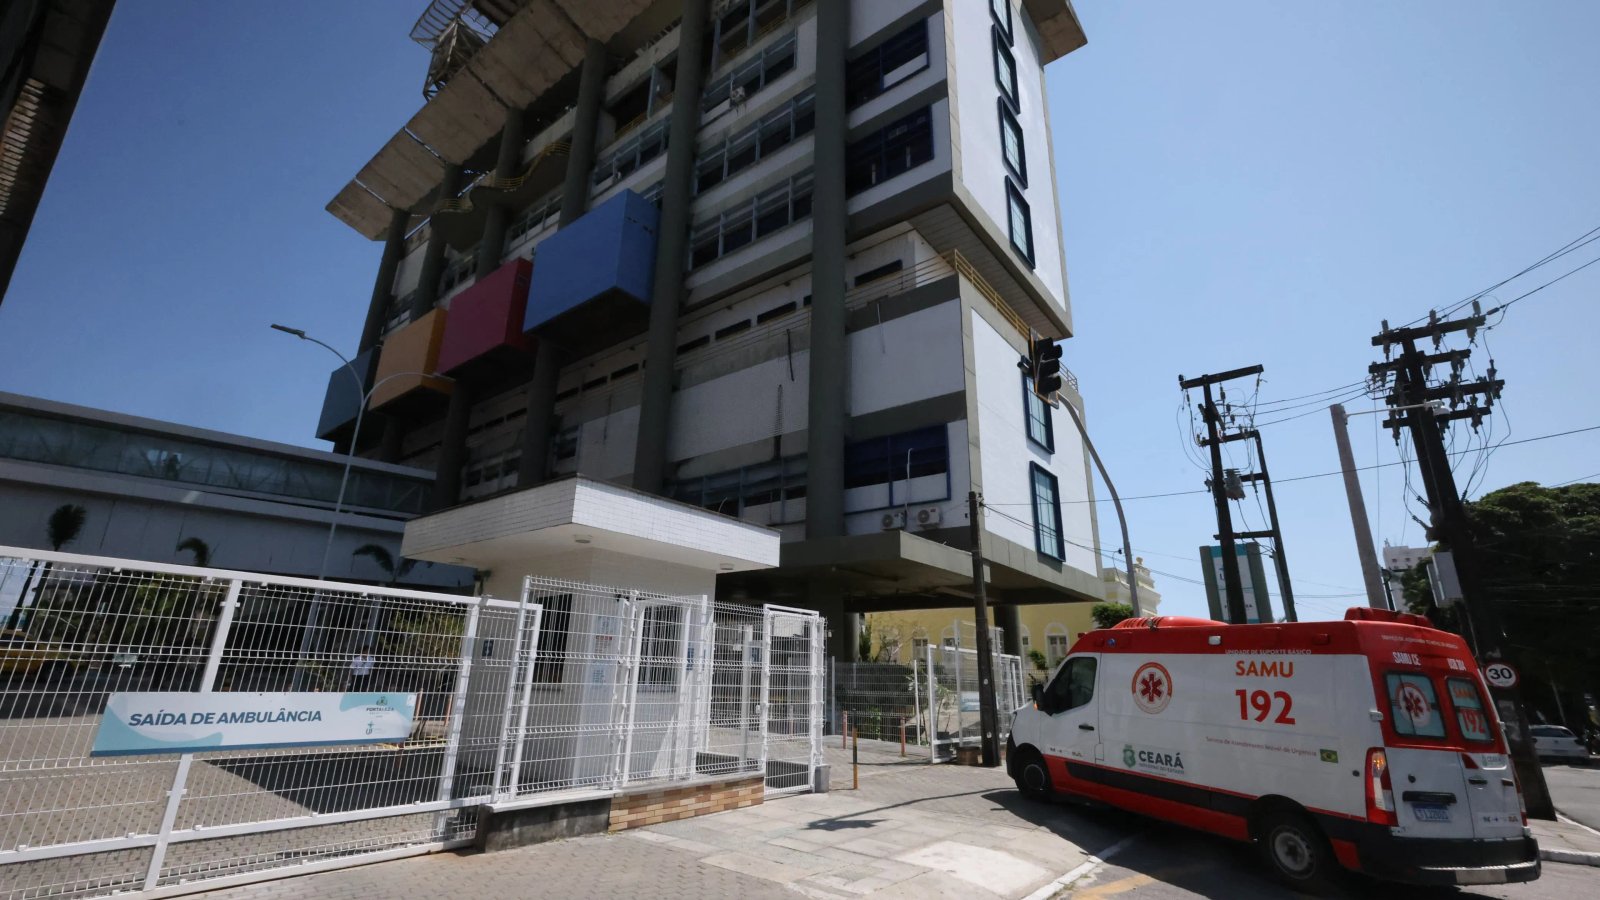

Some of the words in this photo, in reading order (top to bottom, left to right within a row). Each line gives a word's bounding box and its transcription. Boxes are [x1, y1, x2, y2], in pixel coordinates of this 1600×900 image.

[1235, 660, 1294, 679] SAMU
[1488, 667, 1513, 680] 30
[128, 709, 187, 727] SAÍDA
[190, 712, 216, 725] DE
[217, 707, 322, 725] AMBULÂNCIA
[1235, 689, 1296, 725] 192
[1138, 750, 1184, 770] CEARÁ
